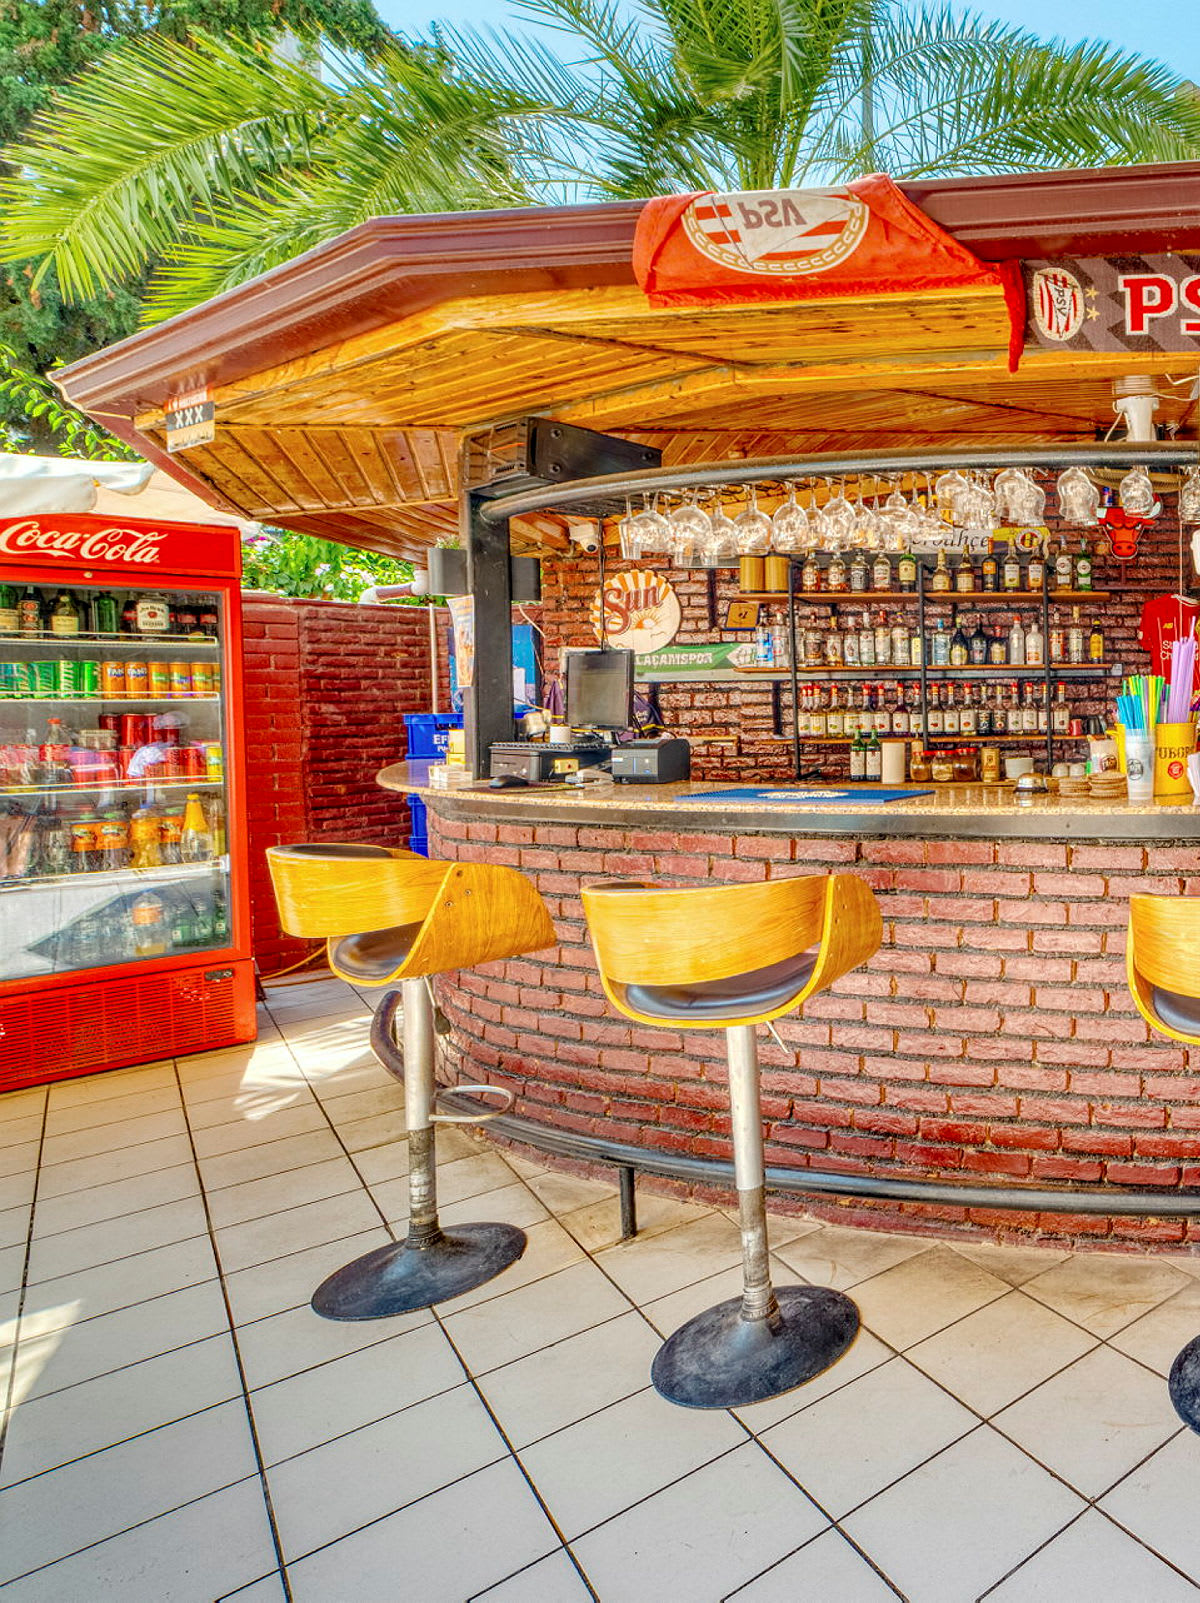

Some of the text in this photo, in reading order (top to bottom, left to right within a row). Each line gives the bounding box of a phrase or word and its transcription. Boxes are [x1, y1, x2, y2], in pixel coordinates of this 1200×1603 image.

[1053, 287, 1069, 317] PSV
[174, 404, 205, 429] XXX
[1, 520, 168, 564] Coca-Cola
[604, 585, 663, 635] Sun
[635, 652, 713, 668] LAÇAMSPOR
